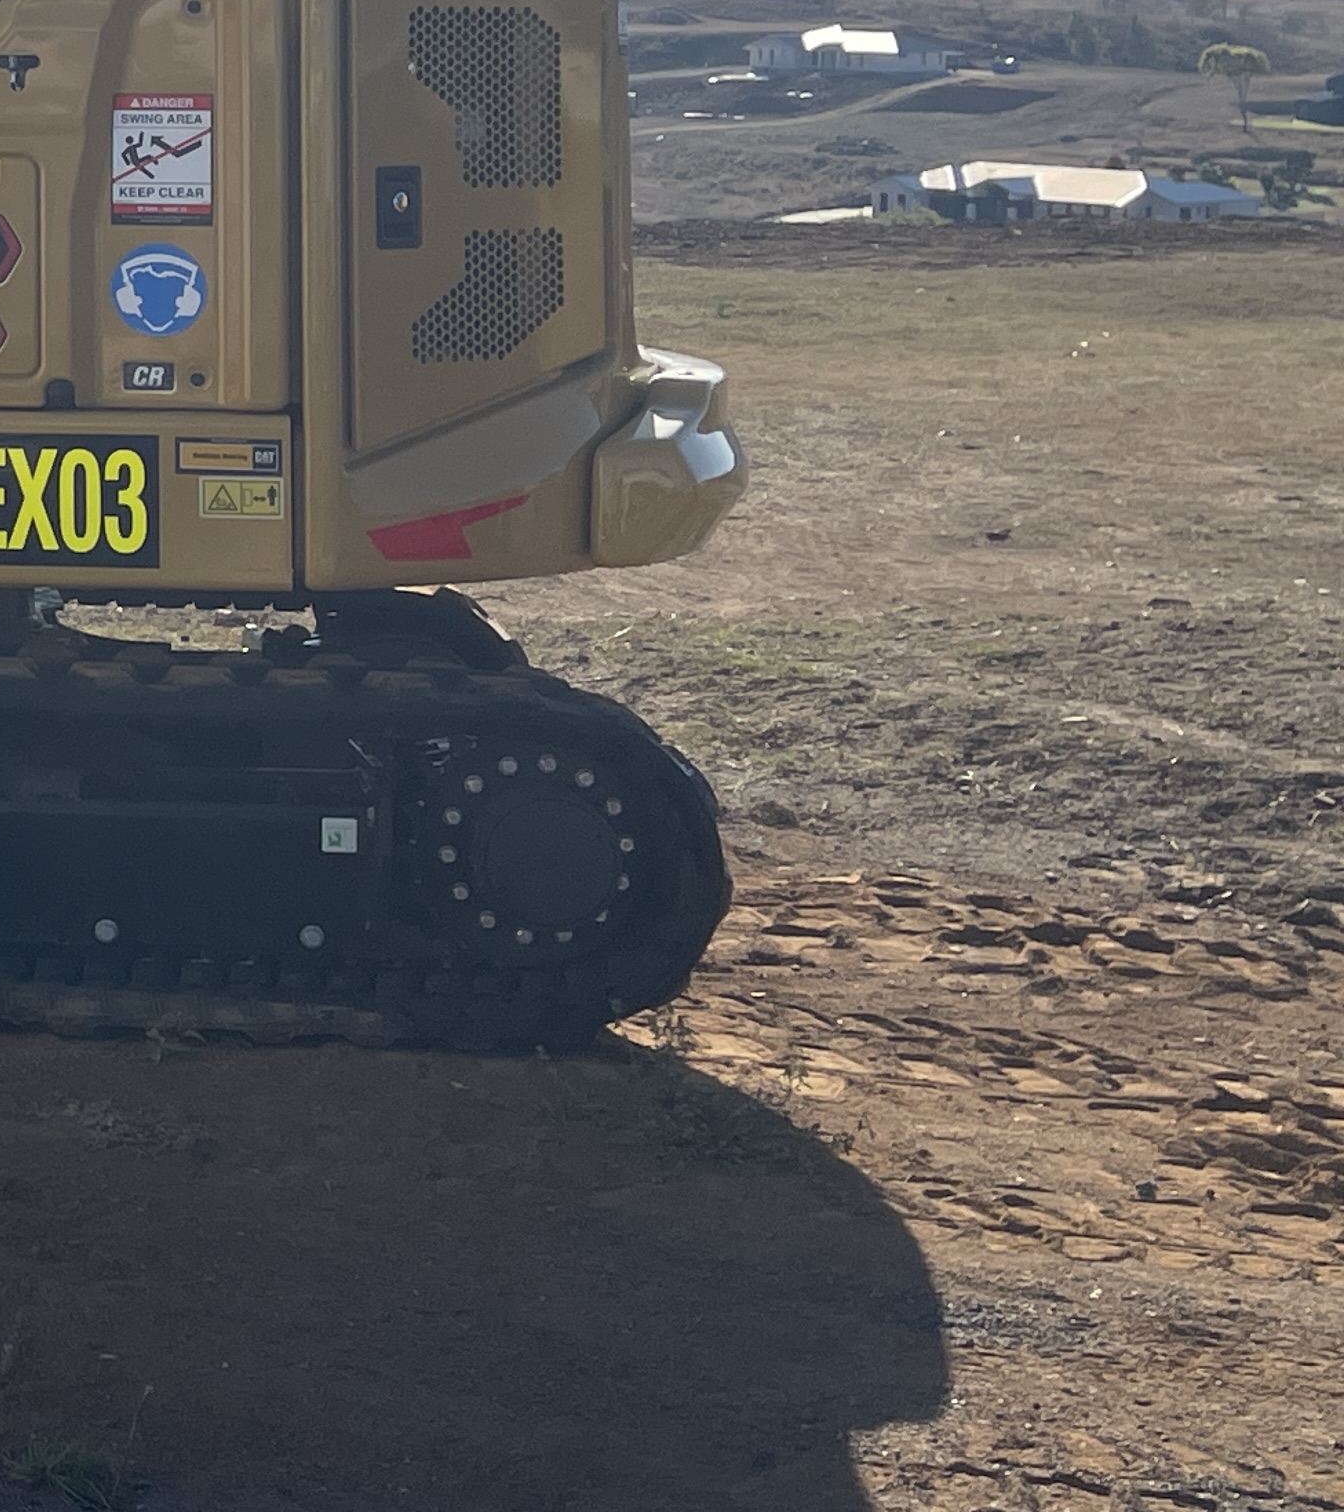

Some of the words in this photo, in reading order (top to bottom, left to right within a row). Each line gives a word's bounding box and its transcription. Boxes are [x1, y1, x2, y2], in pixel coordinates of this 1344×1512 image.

[142, 98, 194, 108] DANGER
[120, 114, 164, 125] SWING
[166, 114, 203, 125] AREA
[119, 187, 155, 198] KEEP
[158, 187, 204, 198] CLEAR
[132, 366, 164, 386] CR
[255, 451, 276, 464] CAT
